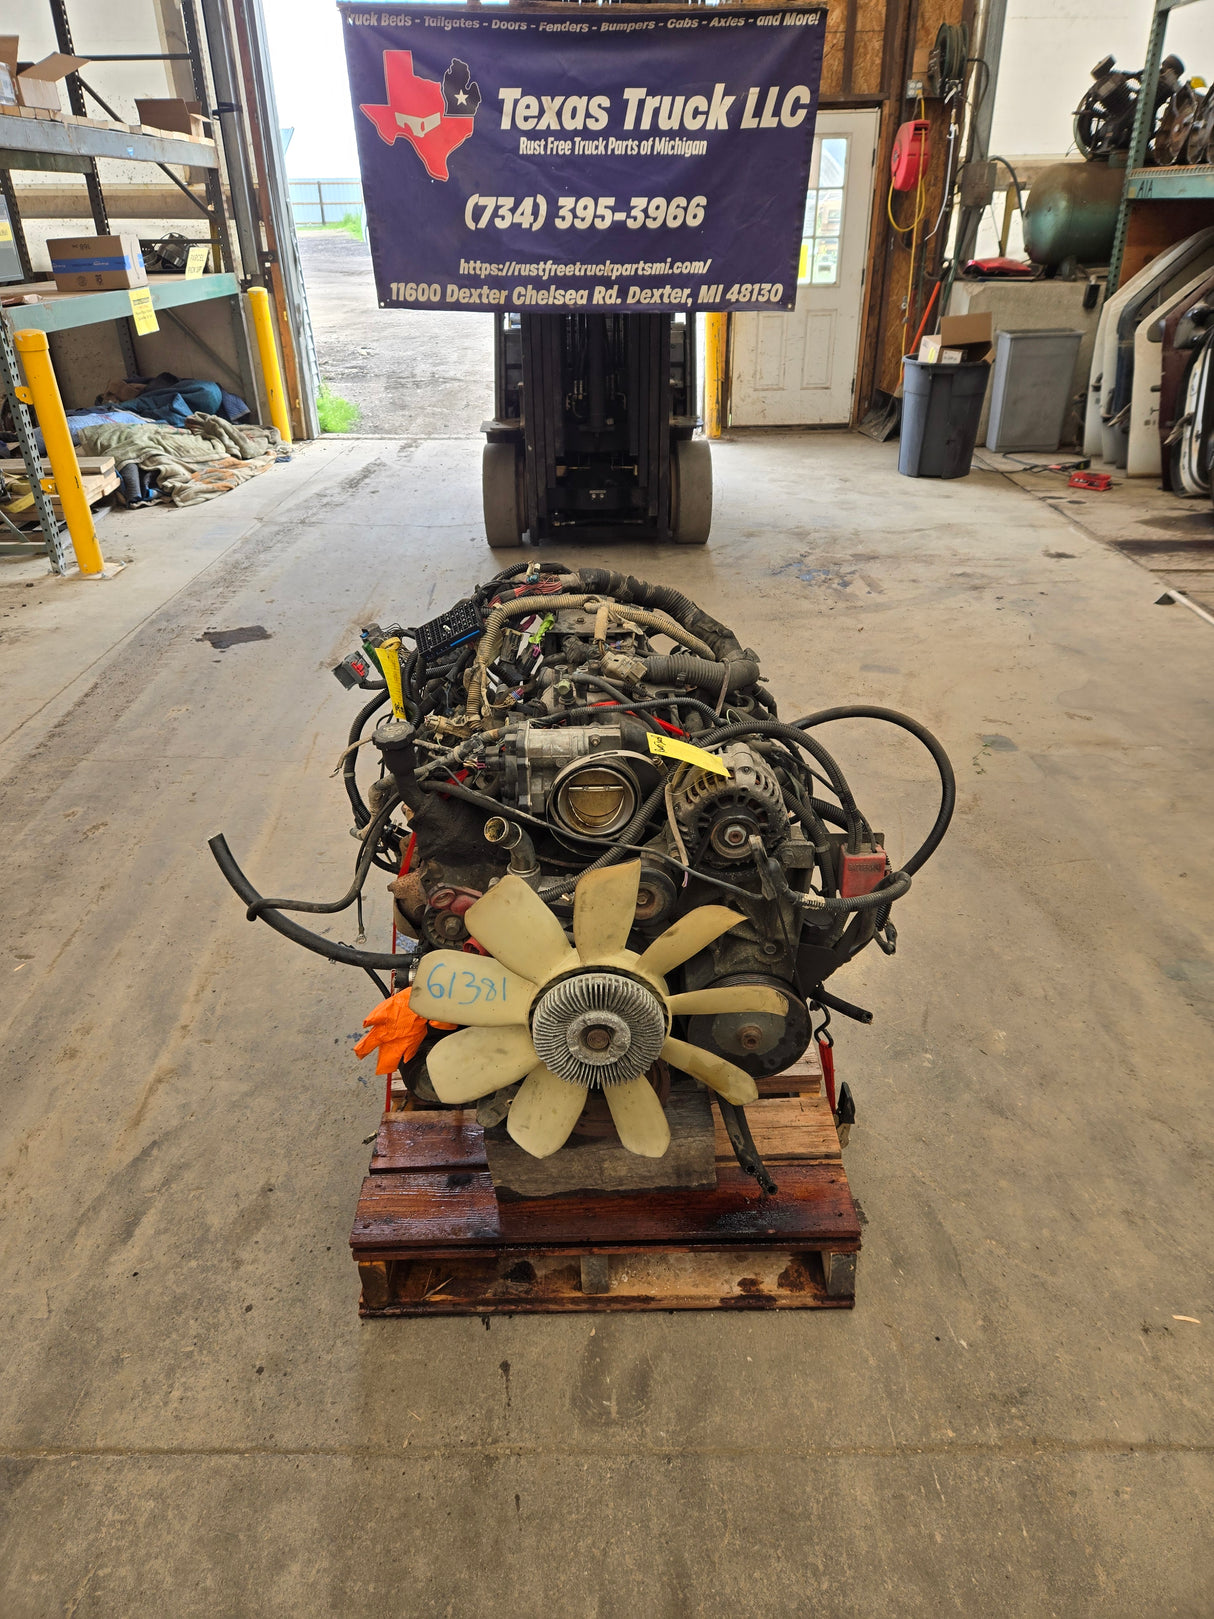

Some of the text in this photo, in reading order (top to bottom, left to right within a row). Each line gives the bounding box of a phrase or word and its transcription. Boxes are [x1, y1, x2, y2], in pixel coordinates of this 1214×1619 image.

[347, 12, 378, 26] ruck
[381, 13, 412, 26] Beds
[424, 15, 480, 31] Tailgates
[491, 19, 527, 31] Doors
[539, 21, 589, 33] Fenders
[600, 20, 655, 32] Bumpers
[667, 18, 699, 29] Cabs
[709, 16, 745, 27] Axles
[756, 13, 780, 26] and
[783, 11, 820, 26] More!
[498, 83, 811, 131] Texas Truck LLC
[518, 137, 708, 157] Rust Free Truck Parts of Michigan
[464, 193, 707, 231] (734) 395-3966
[459, 258, 712, 280] https://rustfreetruckpartsmi.com/
[390, 282, 783, 306] 11600 Dexter Chelsea Rd. Dexter, MI 48130
[427, 963, 506, 1005] 61381
